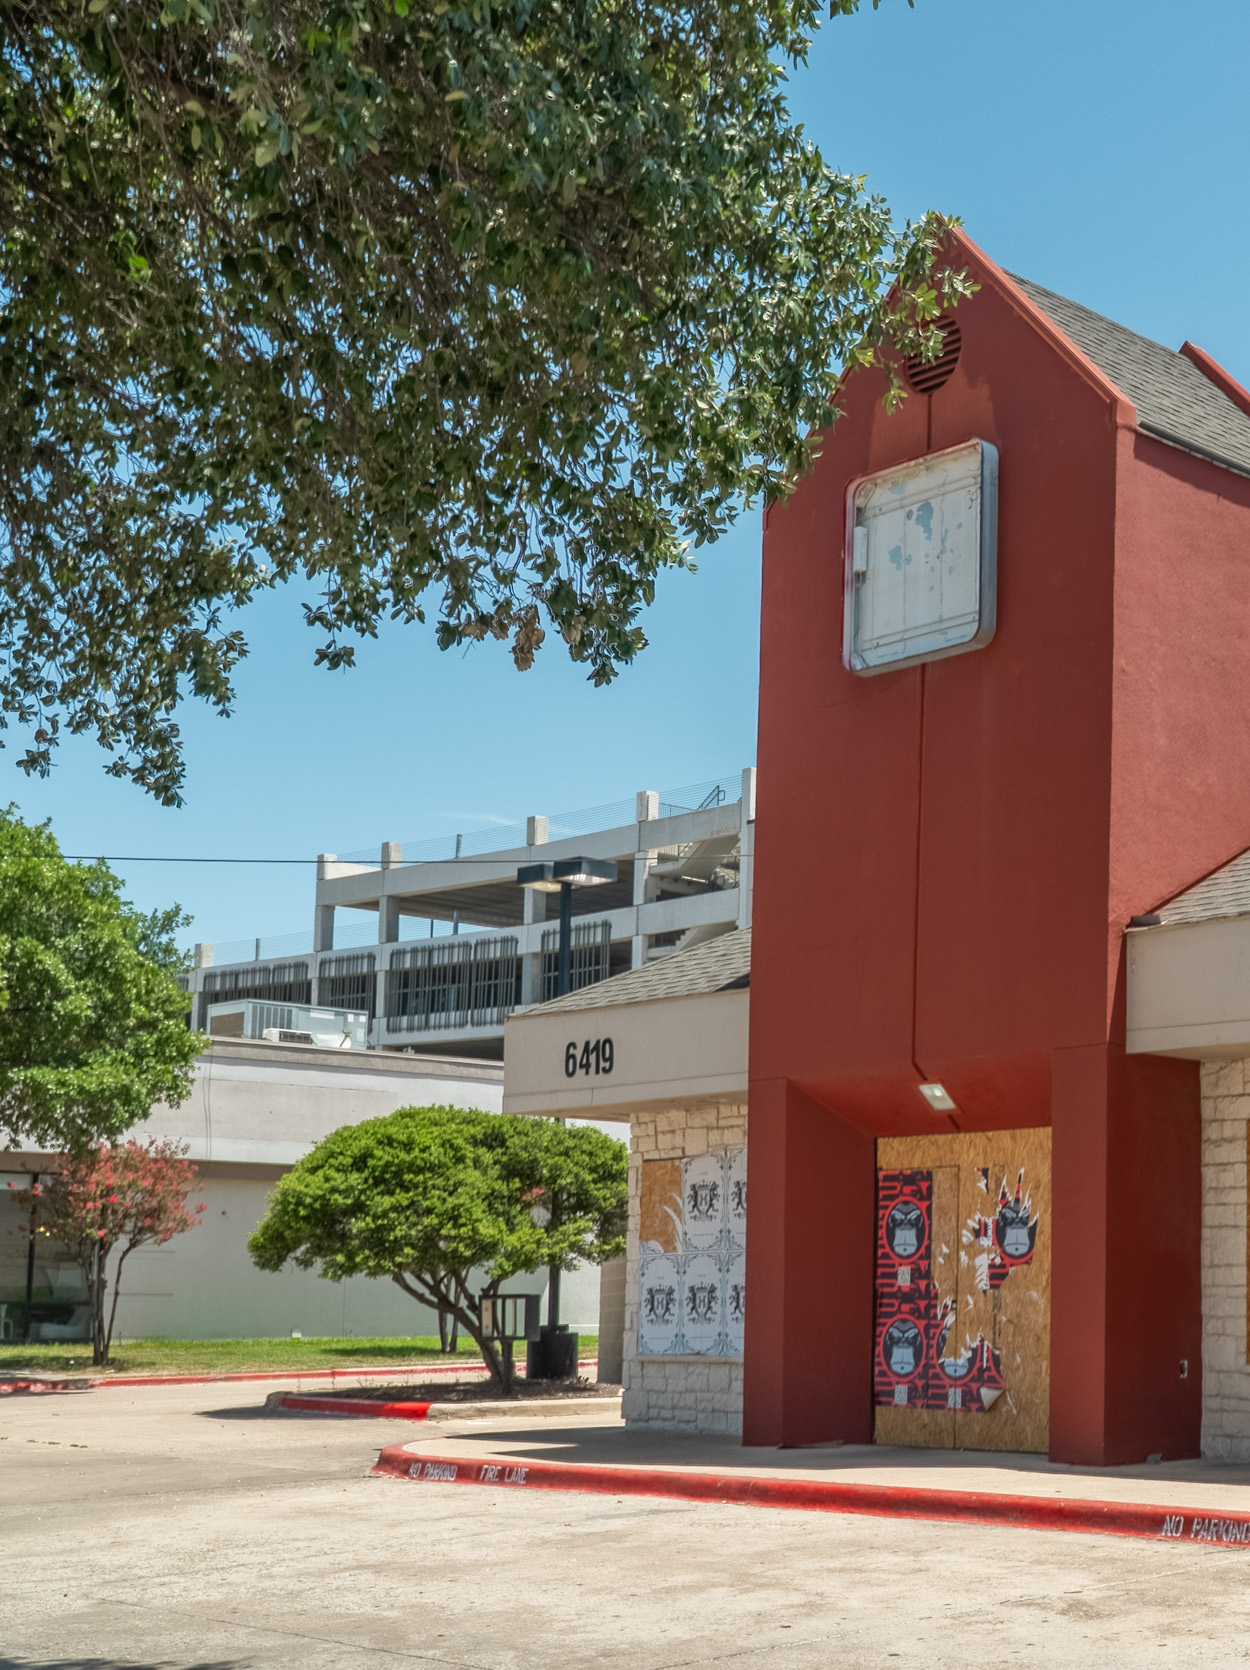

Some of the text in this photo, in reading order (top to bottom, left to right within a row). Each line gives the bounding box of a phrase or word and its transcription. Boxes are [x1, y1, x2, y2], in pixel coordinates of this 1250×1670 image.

[565, 1037, 614, 1078] 6419
[409, 1462, 529, 1484] NO PARKING FIRE LANE
[1161, 1515, 1184, 1537] NO
